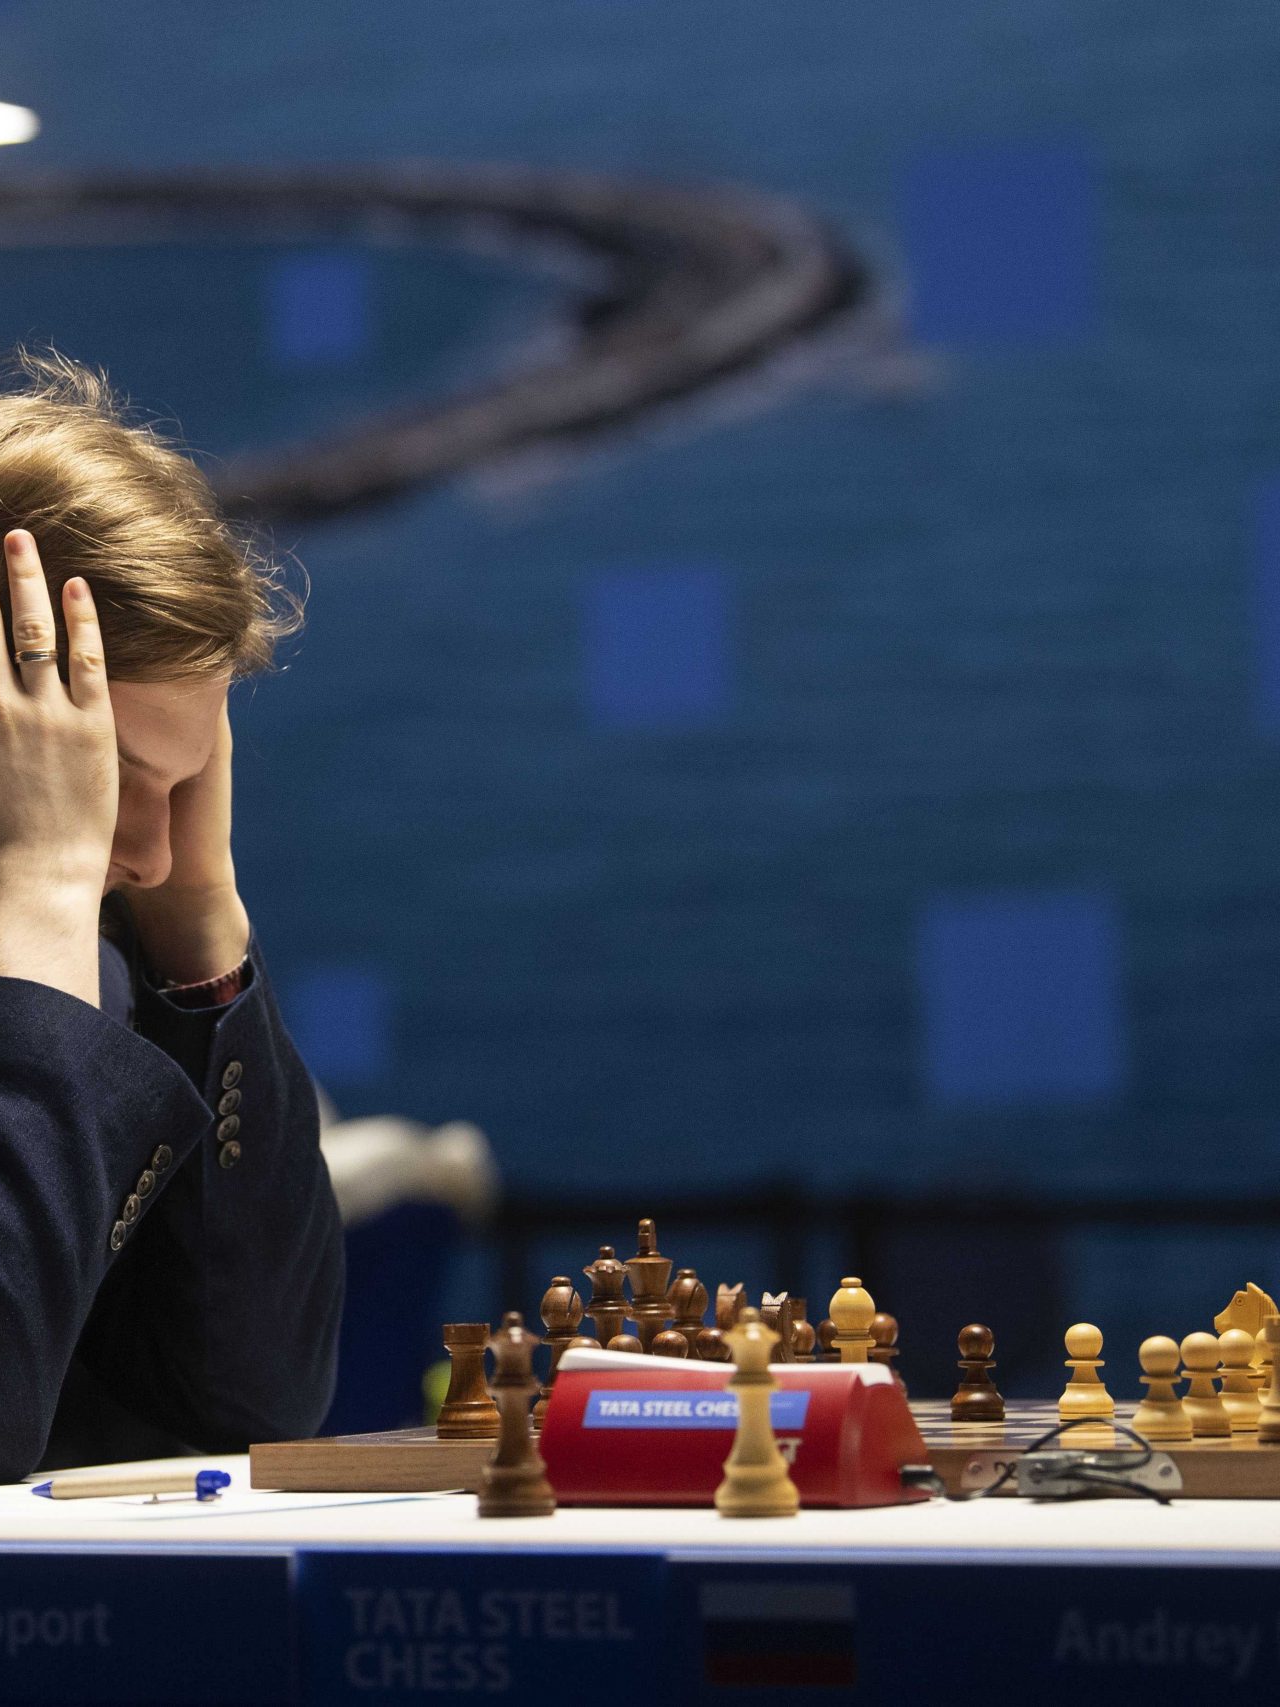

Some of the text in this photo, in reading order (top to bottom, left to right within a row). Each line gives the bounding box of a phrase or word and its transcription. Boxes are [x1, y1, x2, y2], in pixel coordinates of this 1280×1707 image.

[599, 1400, 740, 1417] TATA STEEL CHES
[344, 1588, 634, 1641] TATA STEEL
[344, 1641, 512, 1691] CHESS
[1054, 1607, 1259, 1678] Andrey
